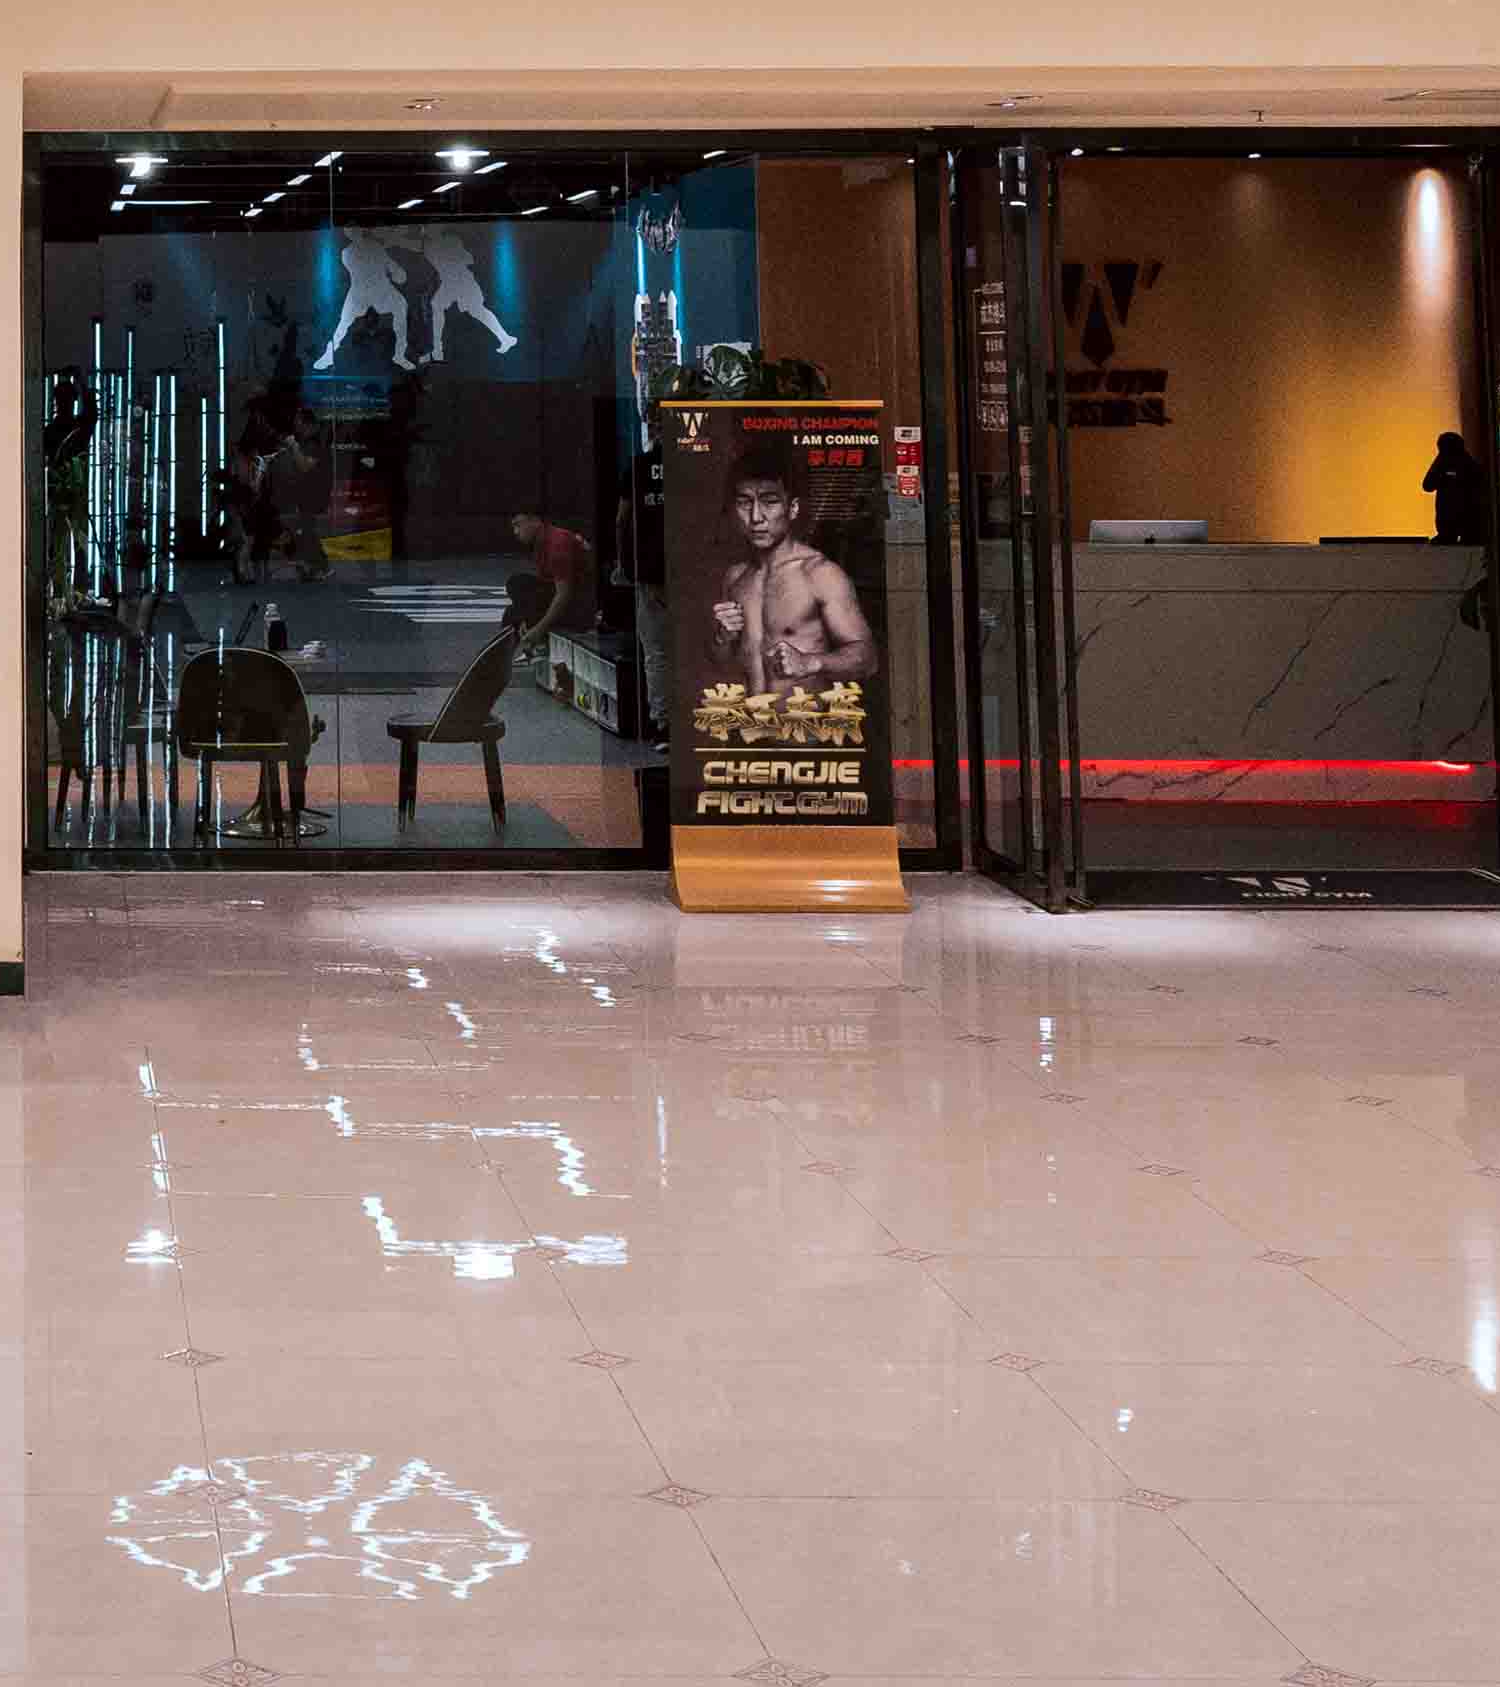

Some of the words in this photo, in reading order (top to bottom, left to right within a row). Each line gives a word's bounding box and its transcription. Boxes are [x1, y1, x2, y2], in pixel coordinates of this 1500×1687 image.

[792, 434, 799, 446] I
[801, 434, 822, 446] AM
[825, 434, 880, 446] COMING
